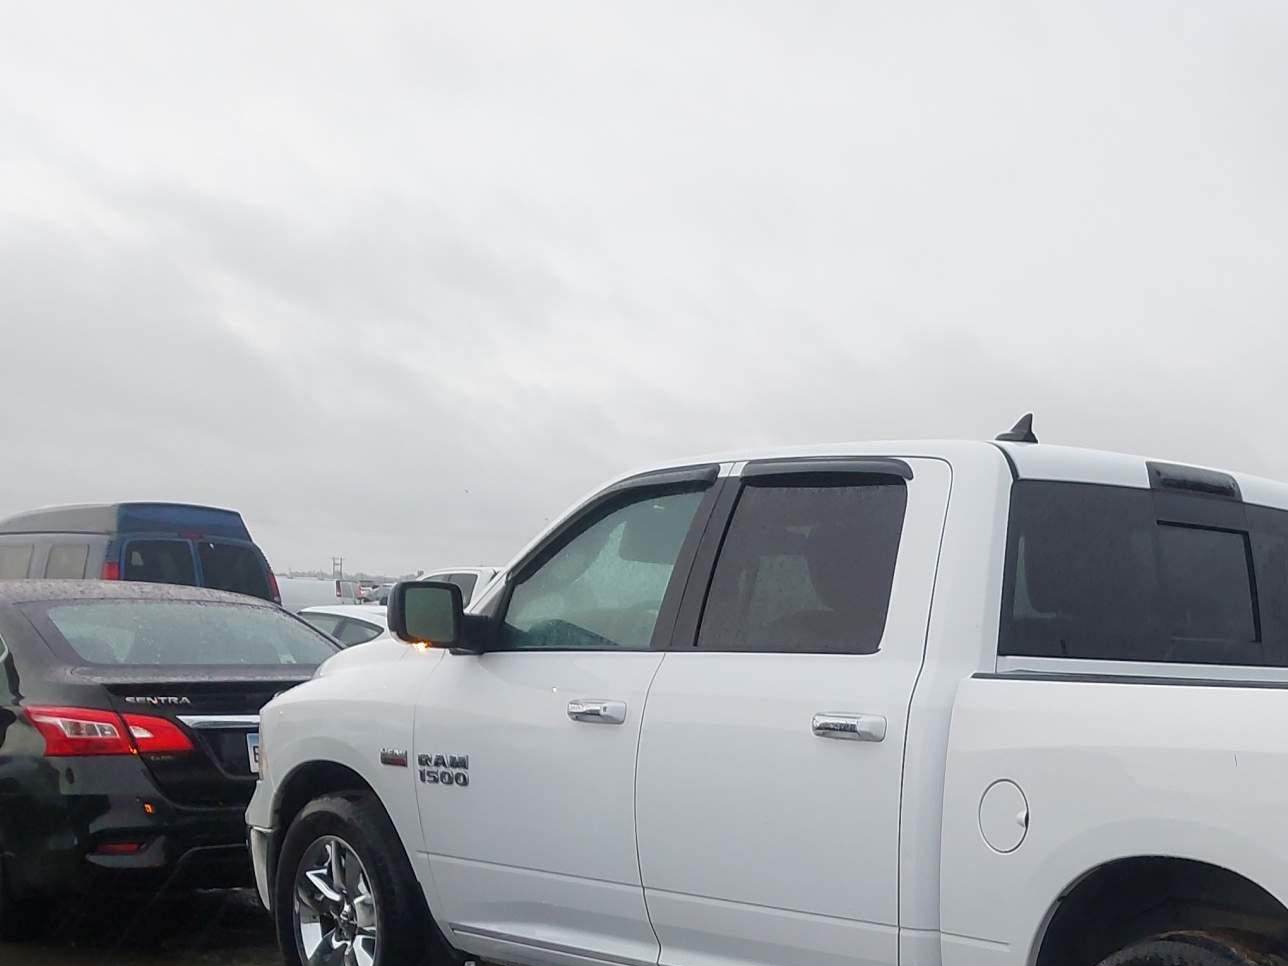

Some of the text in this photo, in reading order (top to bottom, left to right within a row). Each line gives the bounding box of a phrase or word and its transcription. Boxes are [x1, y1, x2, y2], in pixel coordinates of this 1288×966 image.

[125, 696, 191, 705] SENTRA
[417, 753, 469, 770] RAM
[418, 769, 470, 787] 1500
